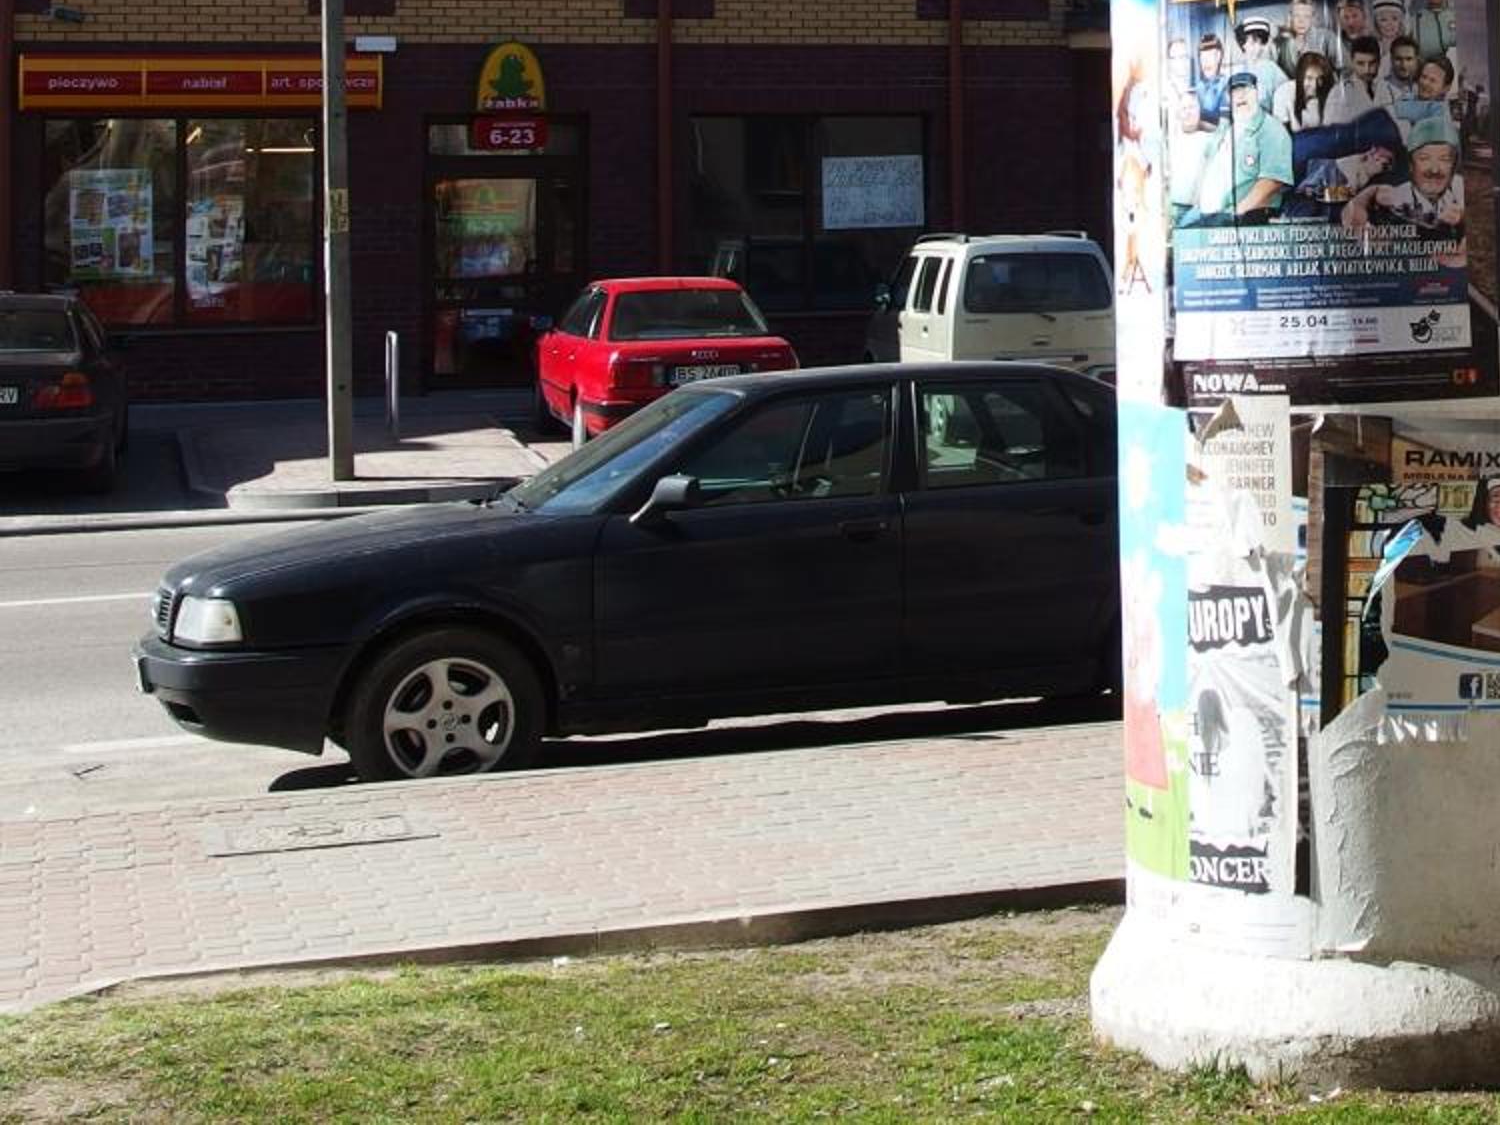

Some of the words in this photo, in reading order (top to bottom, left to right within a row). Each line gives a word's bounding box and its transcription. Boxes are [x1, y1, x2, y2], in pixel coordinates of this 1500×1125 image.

[48, 77, 118, 89] pieczywo
[489, 129, 536, 144] 6-23
[1279, 316, 1329, 328] 25.04
[1193, 373, 1259, 392] NOWA
